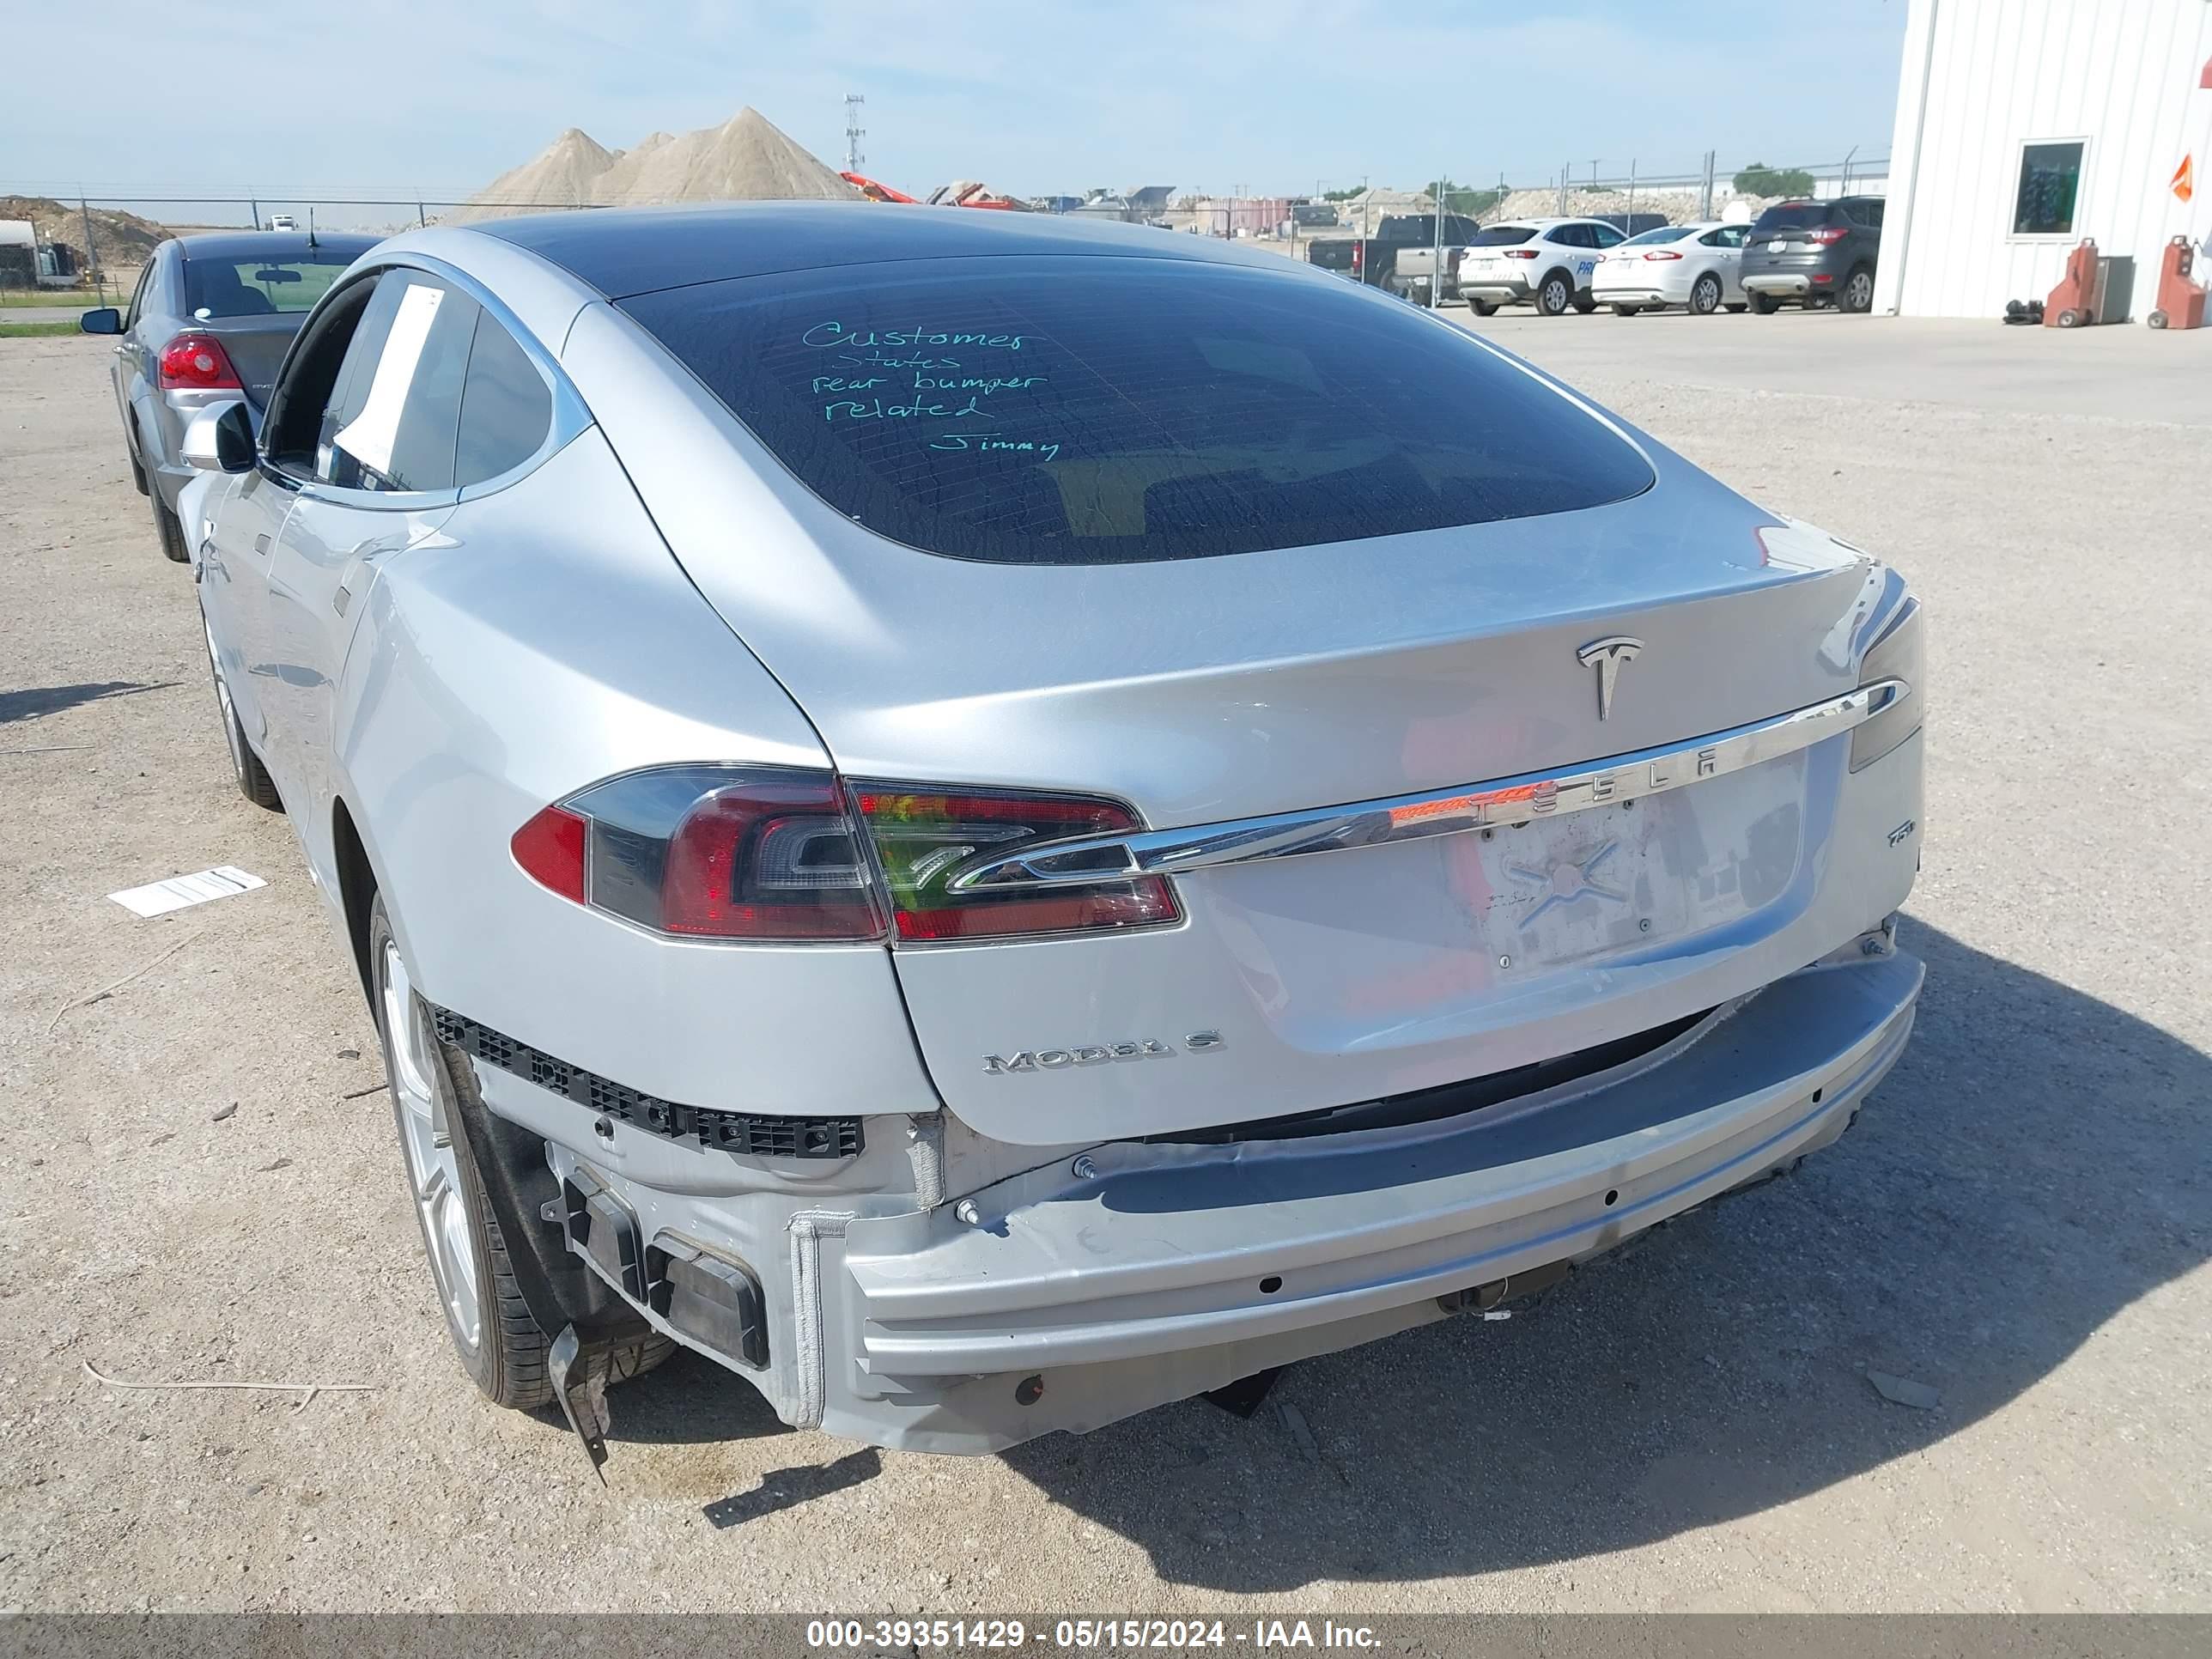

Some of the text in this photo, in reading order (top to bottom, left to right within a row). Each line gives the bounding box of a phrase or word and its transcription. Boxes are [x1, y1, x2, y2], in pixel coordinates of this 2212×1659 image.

[803, 322, 1047, 349] Customer
[811, 371, 1048, 395] rear bumper
[824, 395, 994, 421] related
[929, 433, 1060, 462] Jimmy
[1468, 748, 1717, 824] TESLA
[981, 1030, 1220, 1073] MODEL S
